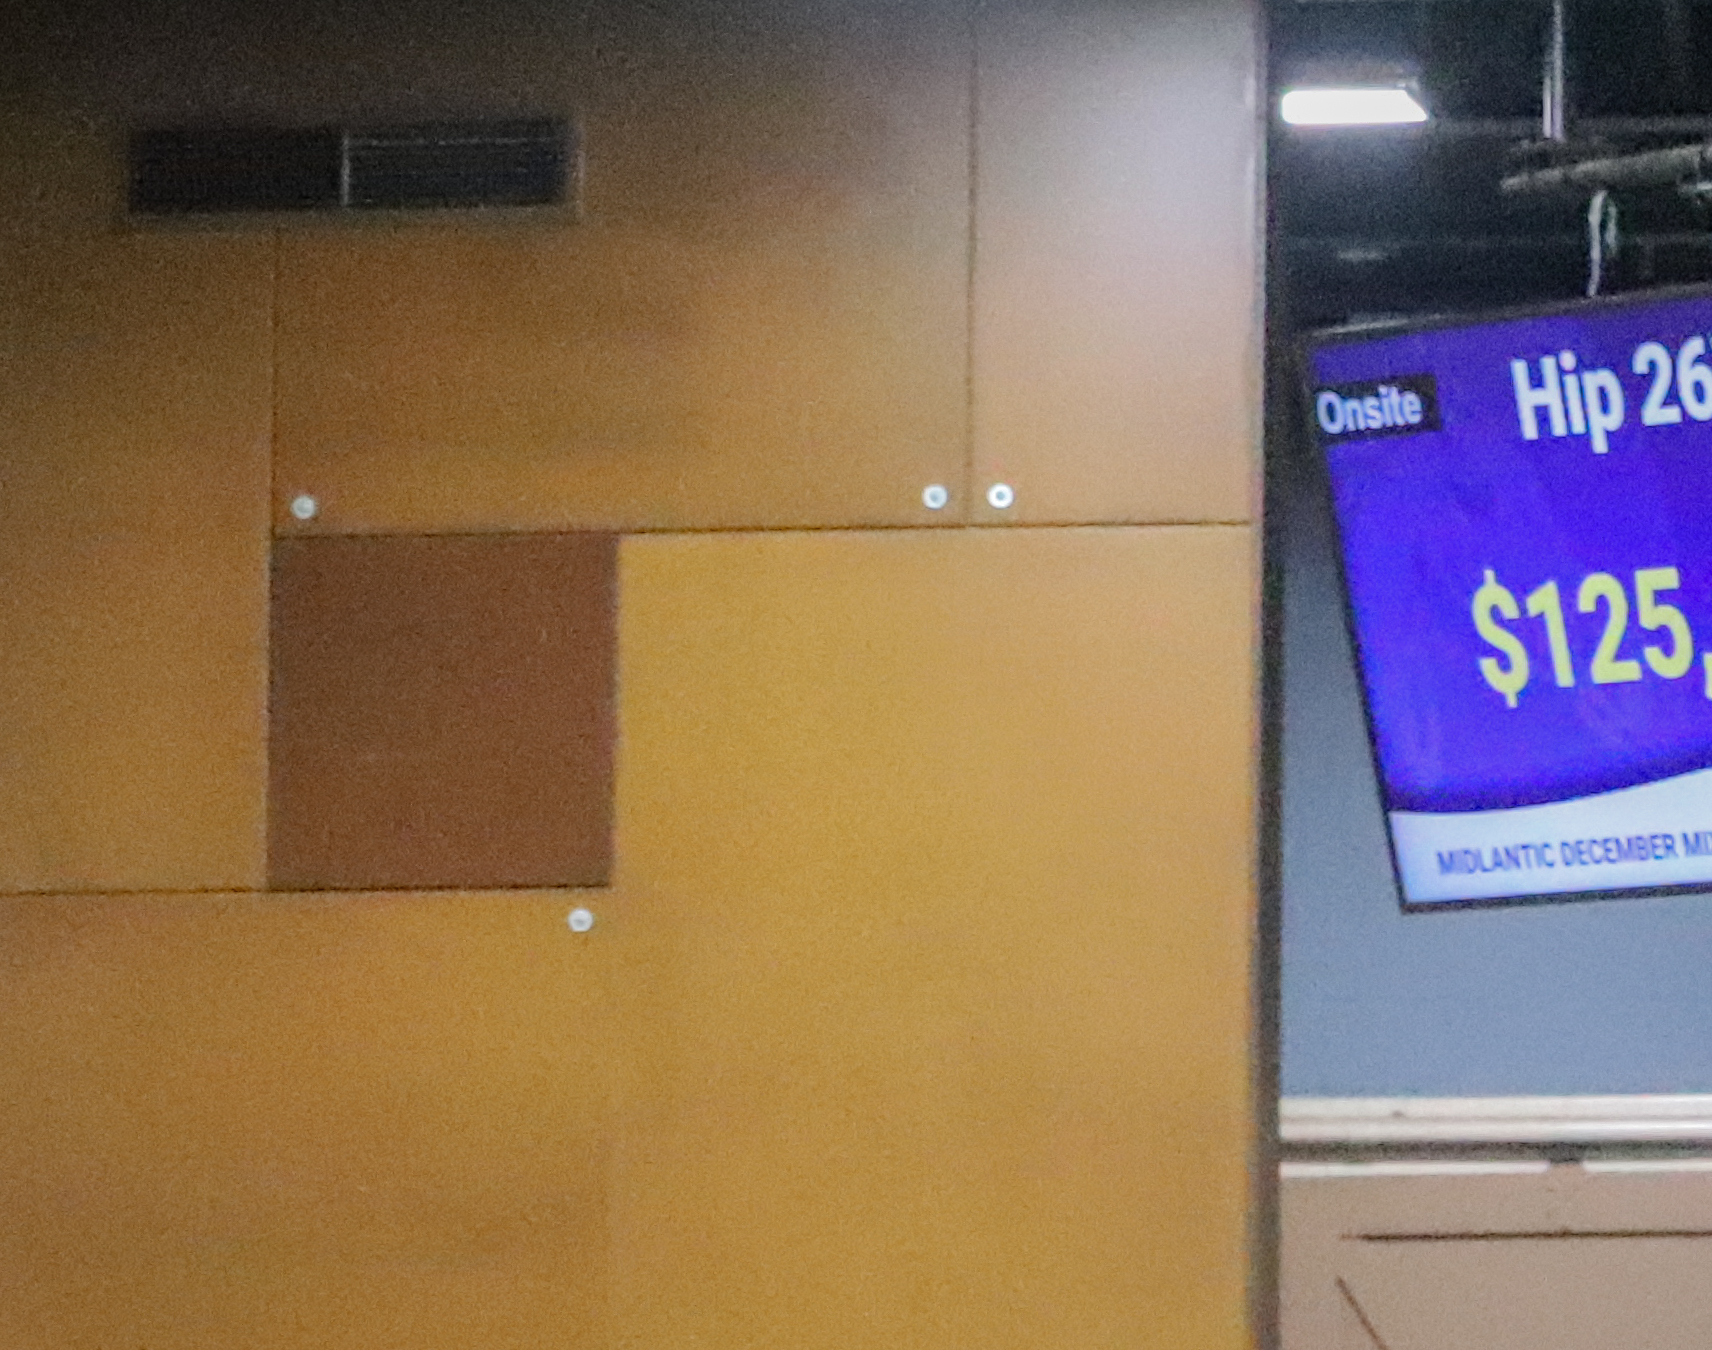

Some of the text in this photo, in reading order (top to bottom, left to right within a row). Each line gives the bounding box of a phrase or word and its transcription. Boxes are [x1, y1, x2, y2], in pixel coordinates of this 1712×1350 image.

[1316, 385, 1422, 434] Onsite
[1510, 350, 1625, 454] Hip
[1436, 840, 1554, 875] MIDLANTIC
[1560, 832, 1679, 867] DECEMBER
